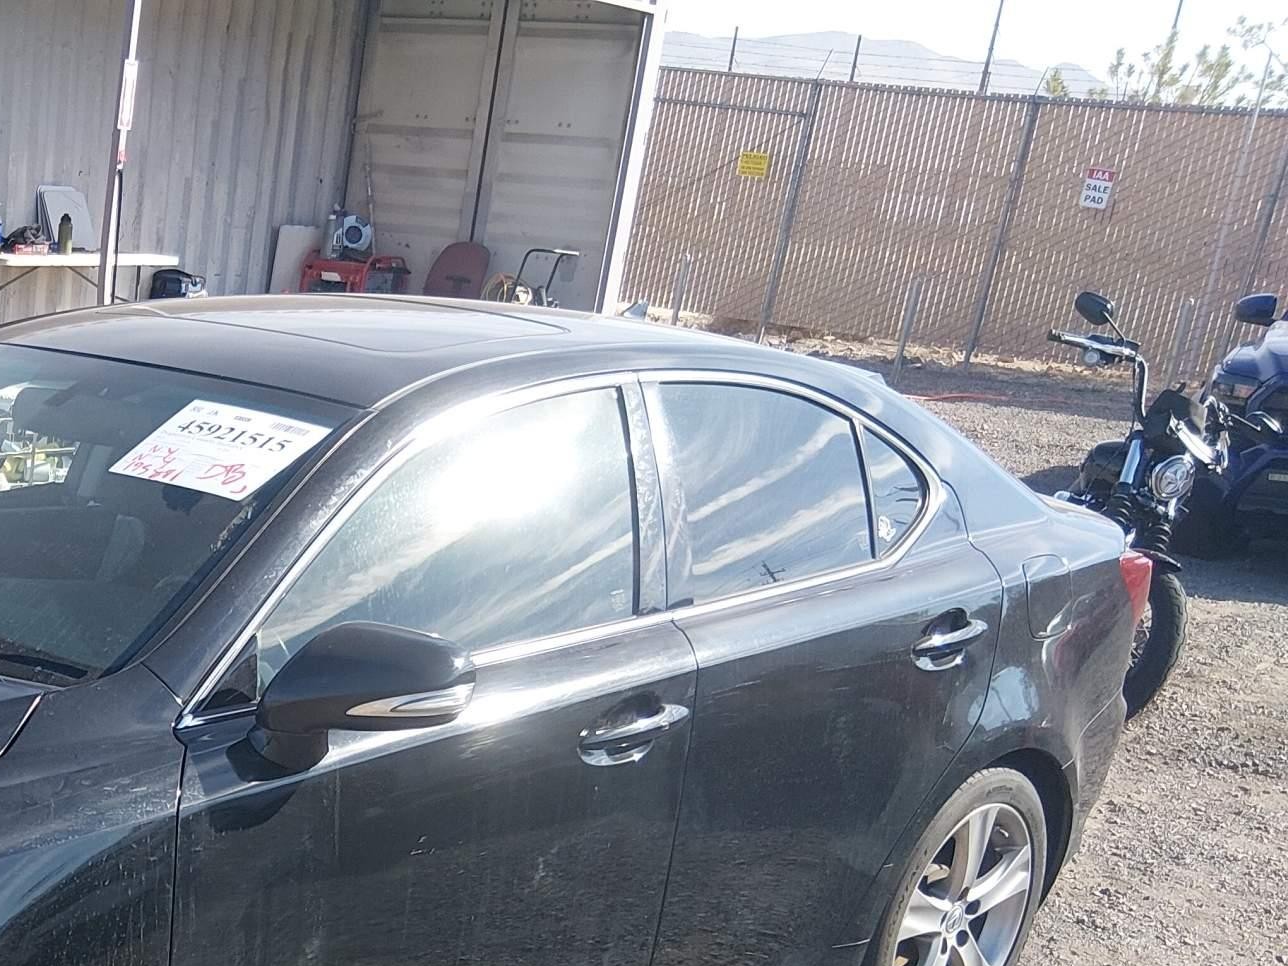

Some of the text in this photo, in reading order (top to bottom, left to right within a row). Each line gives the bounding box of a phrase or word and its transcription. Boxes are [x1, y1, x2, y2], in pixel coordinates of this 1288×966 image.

[1092, 169, 1110, 180] IAA
[1085, 183, 1110, 194] SALE
[1083, 194, 1104, 205] PAD
[177, 418, 293, 452] 45921515
